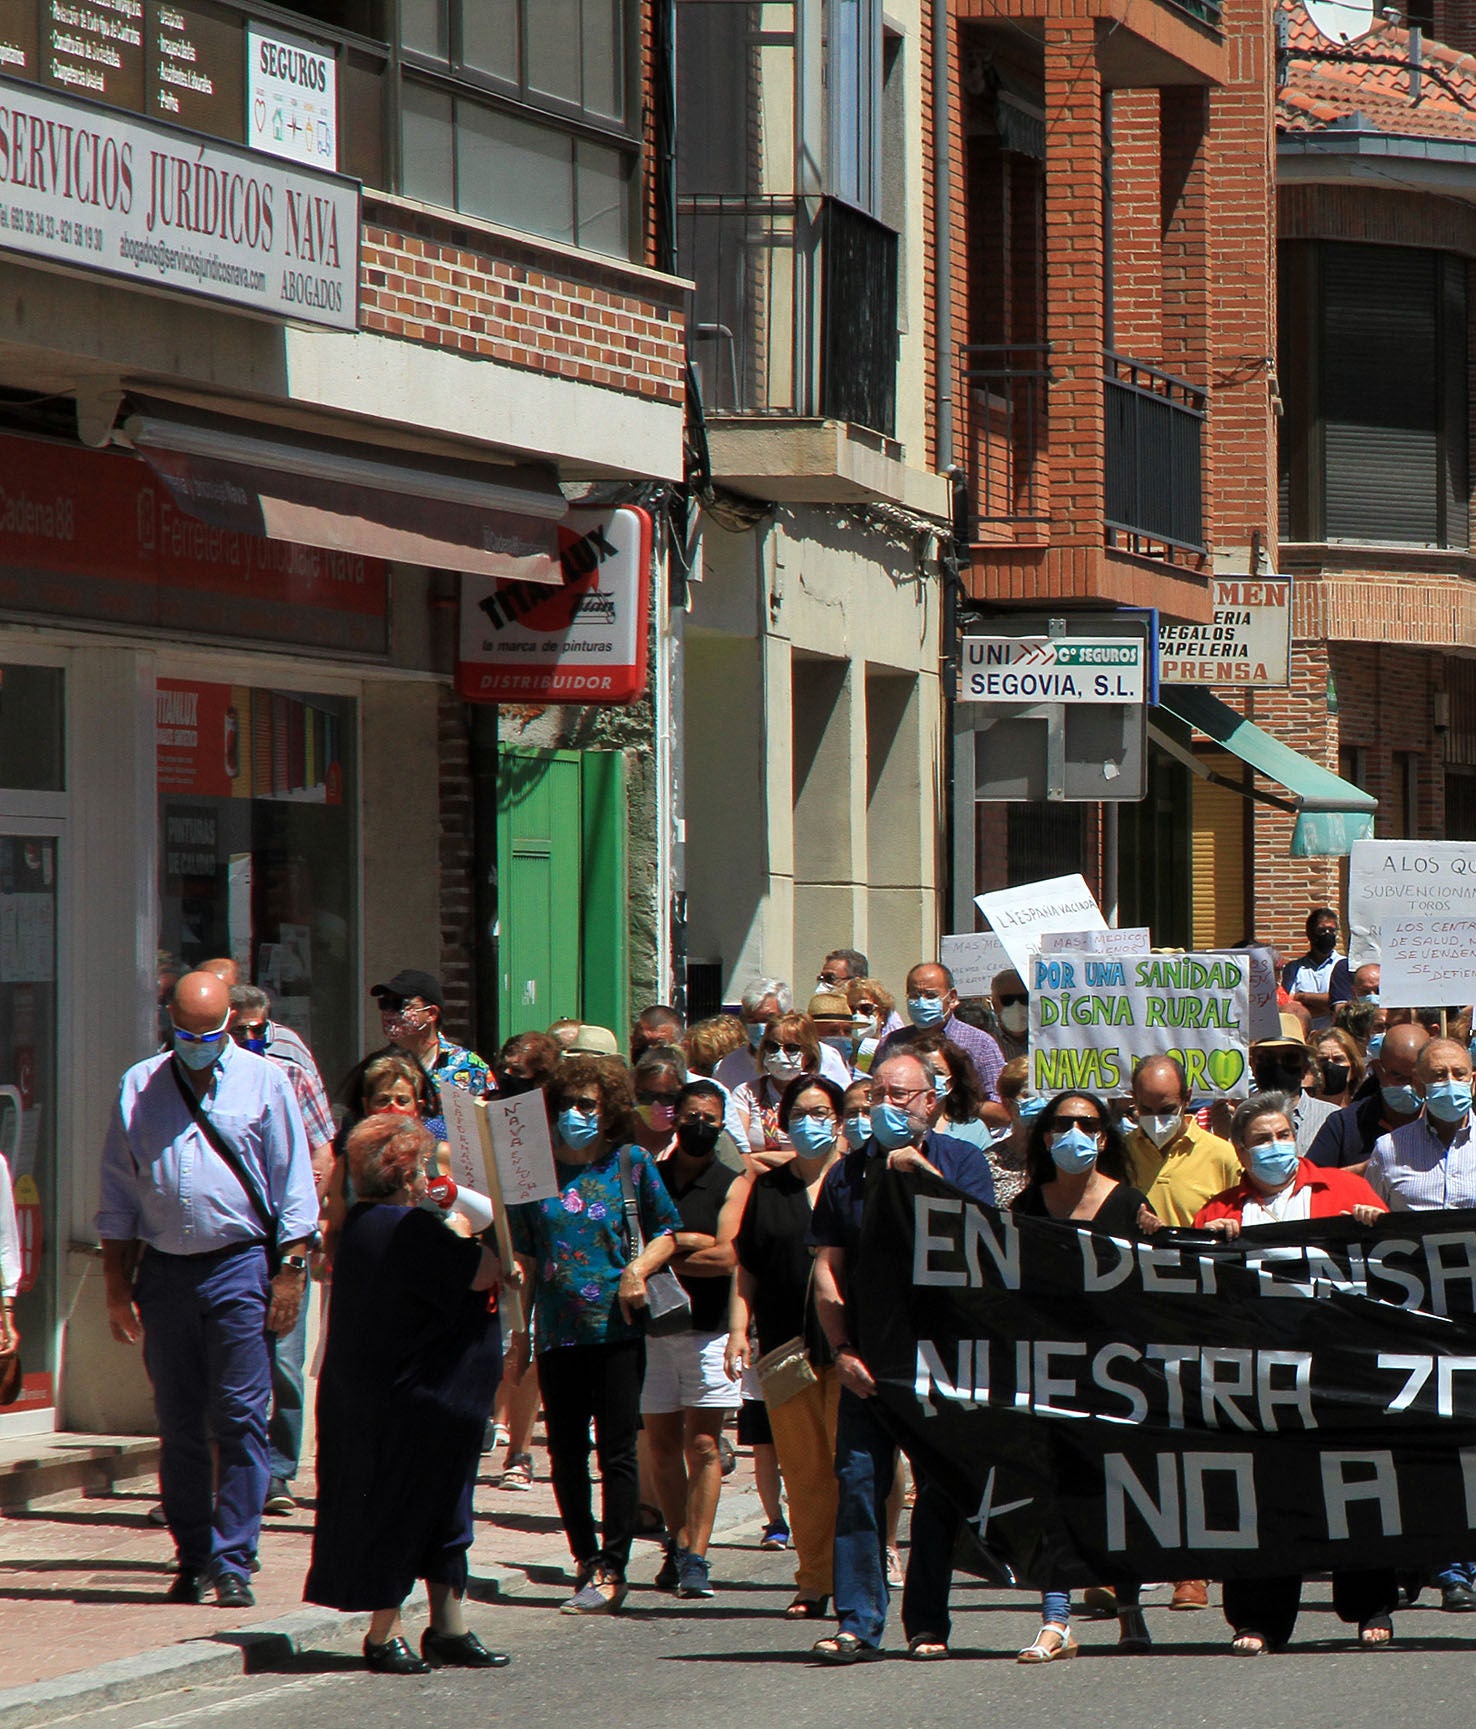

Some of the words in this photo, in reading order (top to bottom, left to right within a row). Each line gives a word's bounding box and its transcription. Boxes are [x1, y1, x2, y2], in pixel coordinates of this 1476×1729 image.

[260, 40, 326, 93] SEGUROS
[0, 106, 132, 215] SERVICIOS
[147, 143, 274, 252] JURÍDICOS
[284, 188, 341, 269] NAVA
[281, 270, 343, 313] ABOGADOS
[1214, 582, 1287, 608] MEN
[1213, 611, 1252, 626] ERIA
[497, 641, 537, 652] marca
[542, 640, 558, 652] de
[562, 640, 613, 654] pinturas
[1079, 646, 1137, 664] SEGUROS
[1159, 643, 1248, 657] PAPELERIA
[1162, 660, 1269, 681] PRENSA
[479, 675, 612, 690] DISTRIBUIDOR
[970, 673, 1083, 698] SEGOVIA,
[1094, 674, 1135, 697] S.L.
[1382, 855, 1397, 873] A
[1402, 856, 1440, 874] LOS
[1409, 900, 1451, 912] TOROS
[1396, 922, 1425, 933] LOS
[1388, 937, 1409, 948] DE
[1394, 950, 1418, 960] SE
[1035, 961, 1077, 990] POR
[1085, 961, 1127, 987] UNA
[1407, 964, 1431, 975] SE
[1145, 996, 1241, 1029] RURAL
[1034, 1047, 1121, 1091] NAVAS
[912, 1194, 1022, 1290] EN
[914, 1339, 1315, 1432] NUESTRA
[1103, 1450, 1259, 1552] NO
[1318, 1448, 1402, 1541] A
